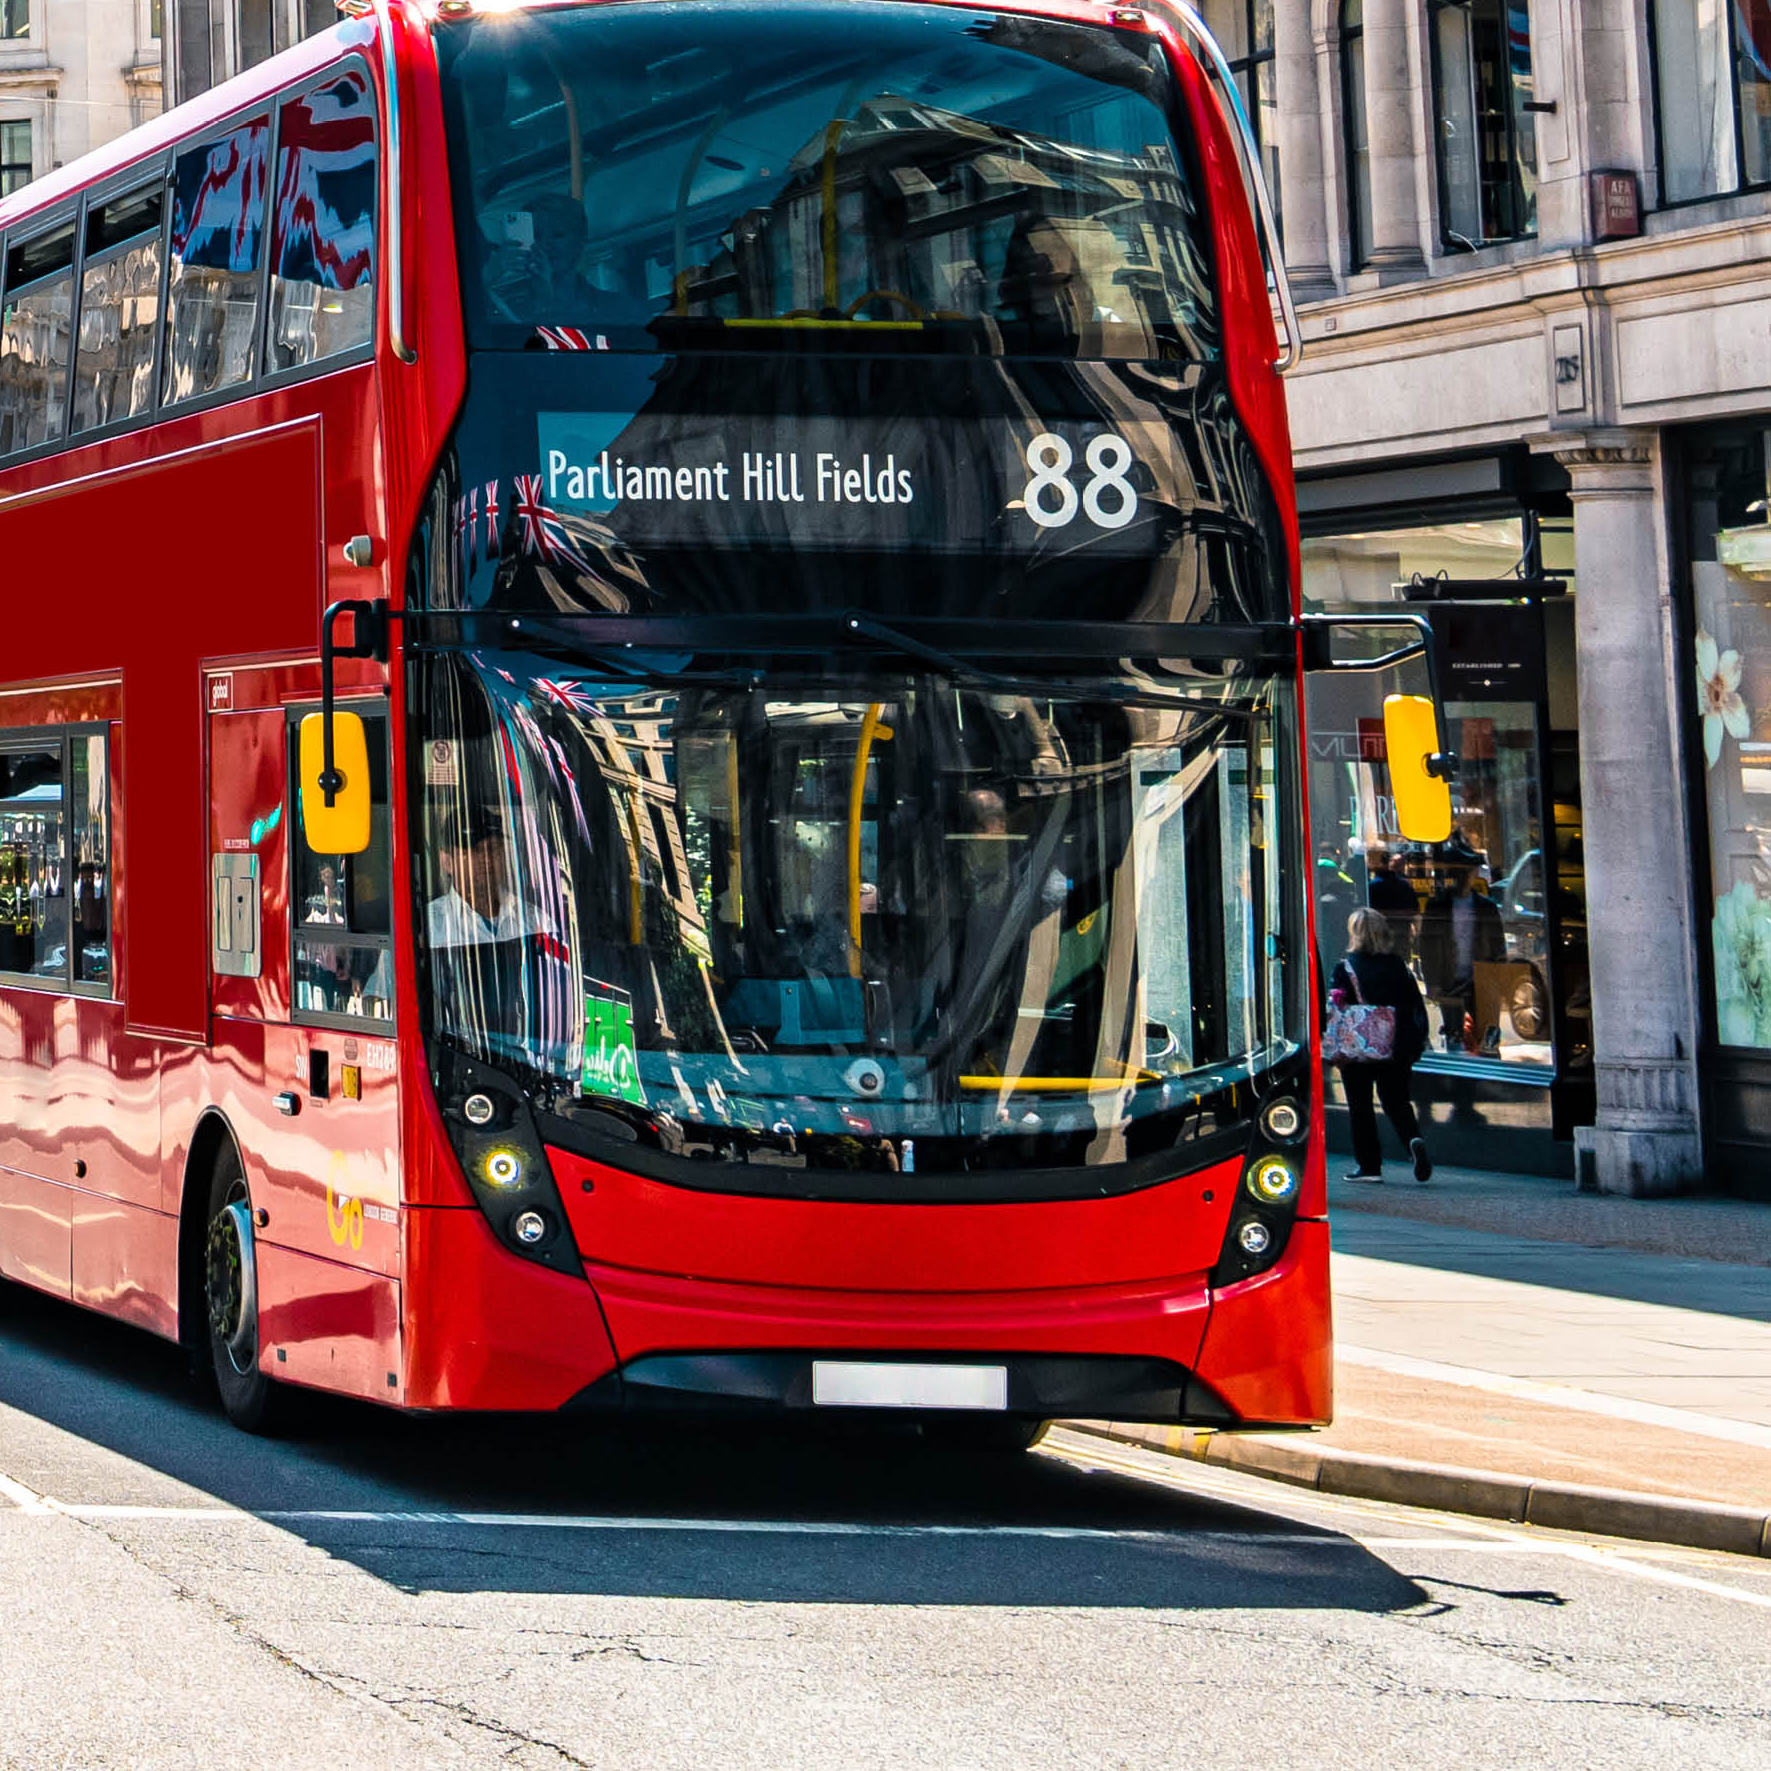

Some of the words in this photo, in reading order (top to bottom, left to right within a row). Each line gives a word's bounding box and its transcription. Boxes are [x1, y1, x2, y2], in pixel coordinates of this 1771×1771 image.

[548, 449, 729, 500] Parliament
[742, 451, 804, 502] Hill
[816, 452, 914, 504] Fields
[1024, 432, 1138, 529] 88
[212, 679, 228, 707] global
